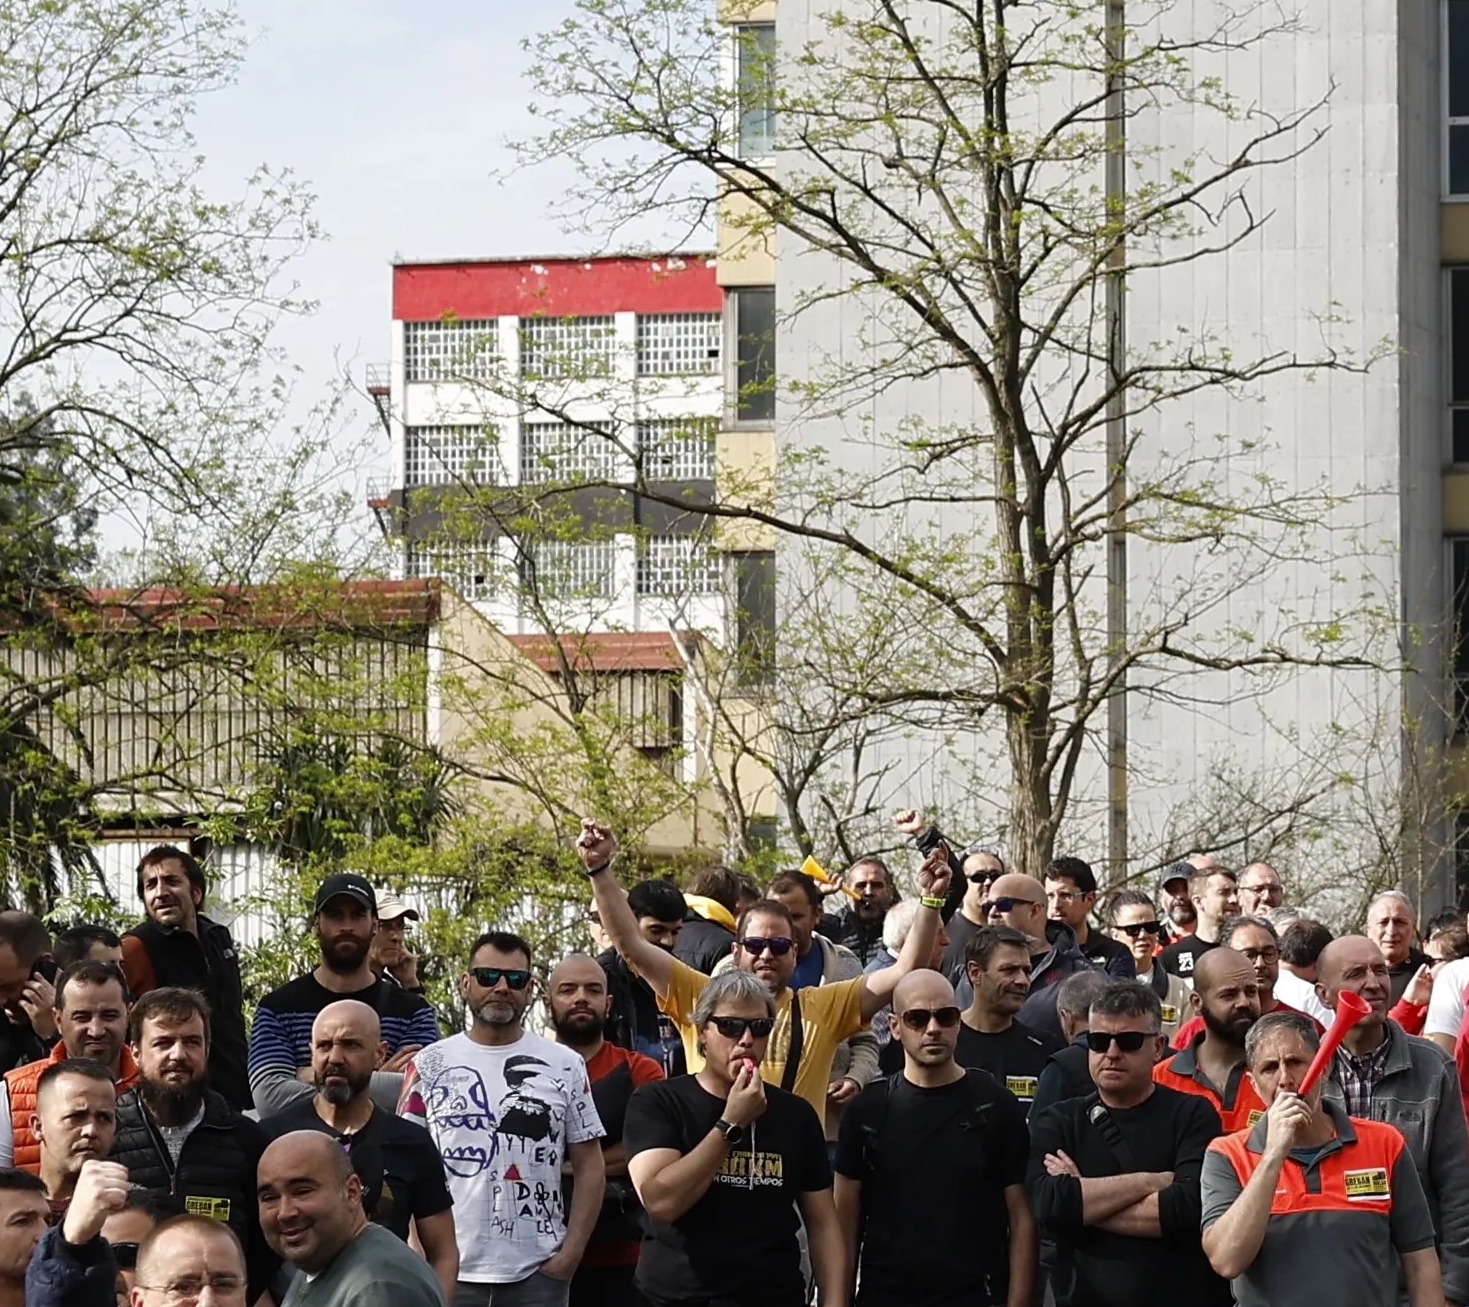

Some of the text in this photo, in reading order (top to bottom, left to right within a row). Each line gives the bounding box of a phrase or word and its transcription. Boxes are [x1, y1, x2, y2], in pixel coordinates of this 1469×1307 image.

[1179, 958, 1194, 972] 23
[720, 1175, 747, 1185] OTROS
[1345, 1176, 1371, 1186] GREBAN
